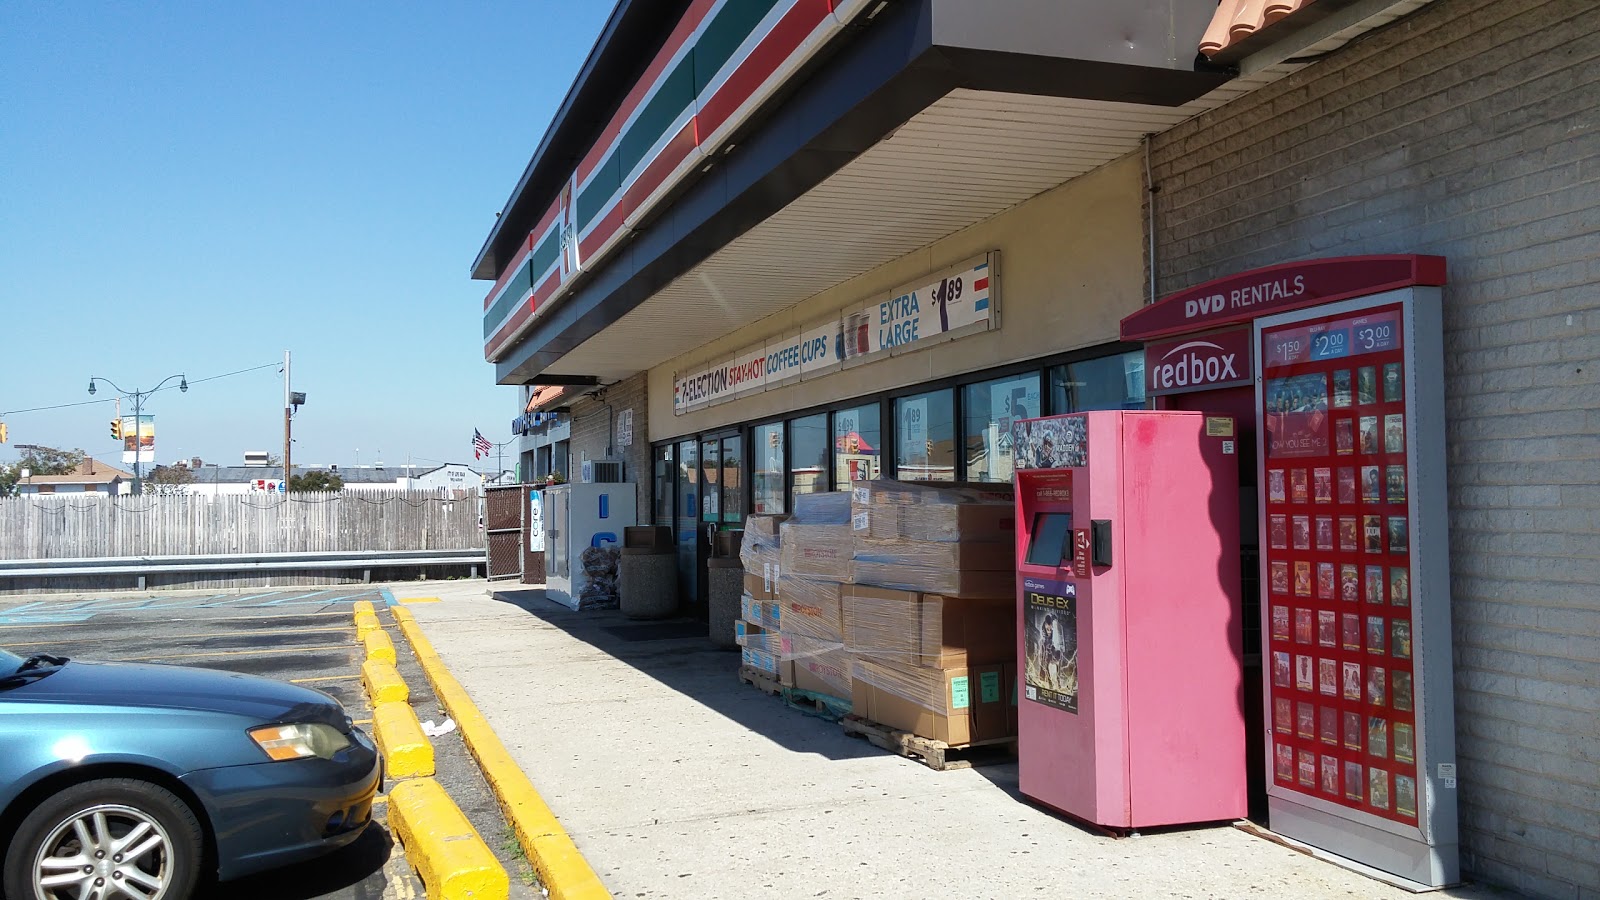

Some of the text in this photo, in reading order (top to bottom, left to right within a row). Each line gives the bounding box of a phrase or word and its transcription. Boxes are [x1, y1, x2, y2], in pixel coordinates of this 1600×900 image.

[880, 292, 920, 325] EXTRA
[1185, 275, 1305, 318] DVD RENTALS
[879, 318, 920, 350] LARGE
[682, 335, 828, 403] 7-ELECTION STAY-HOT COFFEE CUPS
[1153, 353, 1238, 388] redbox
